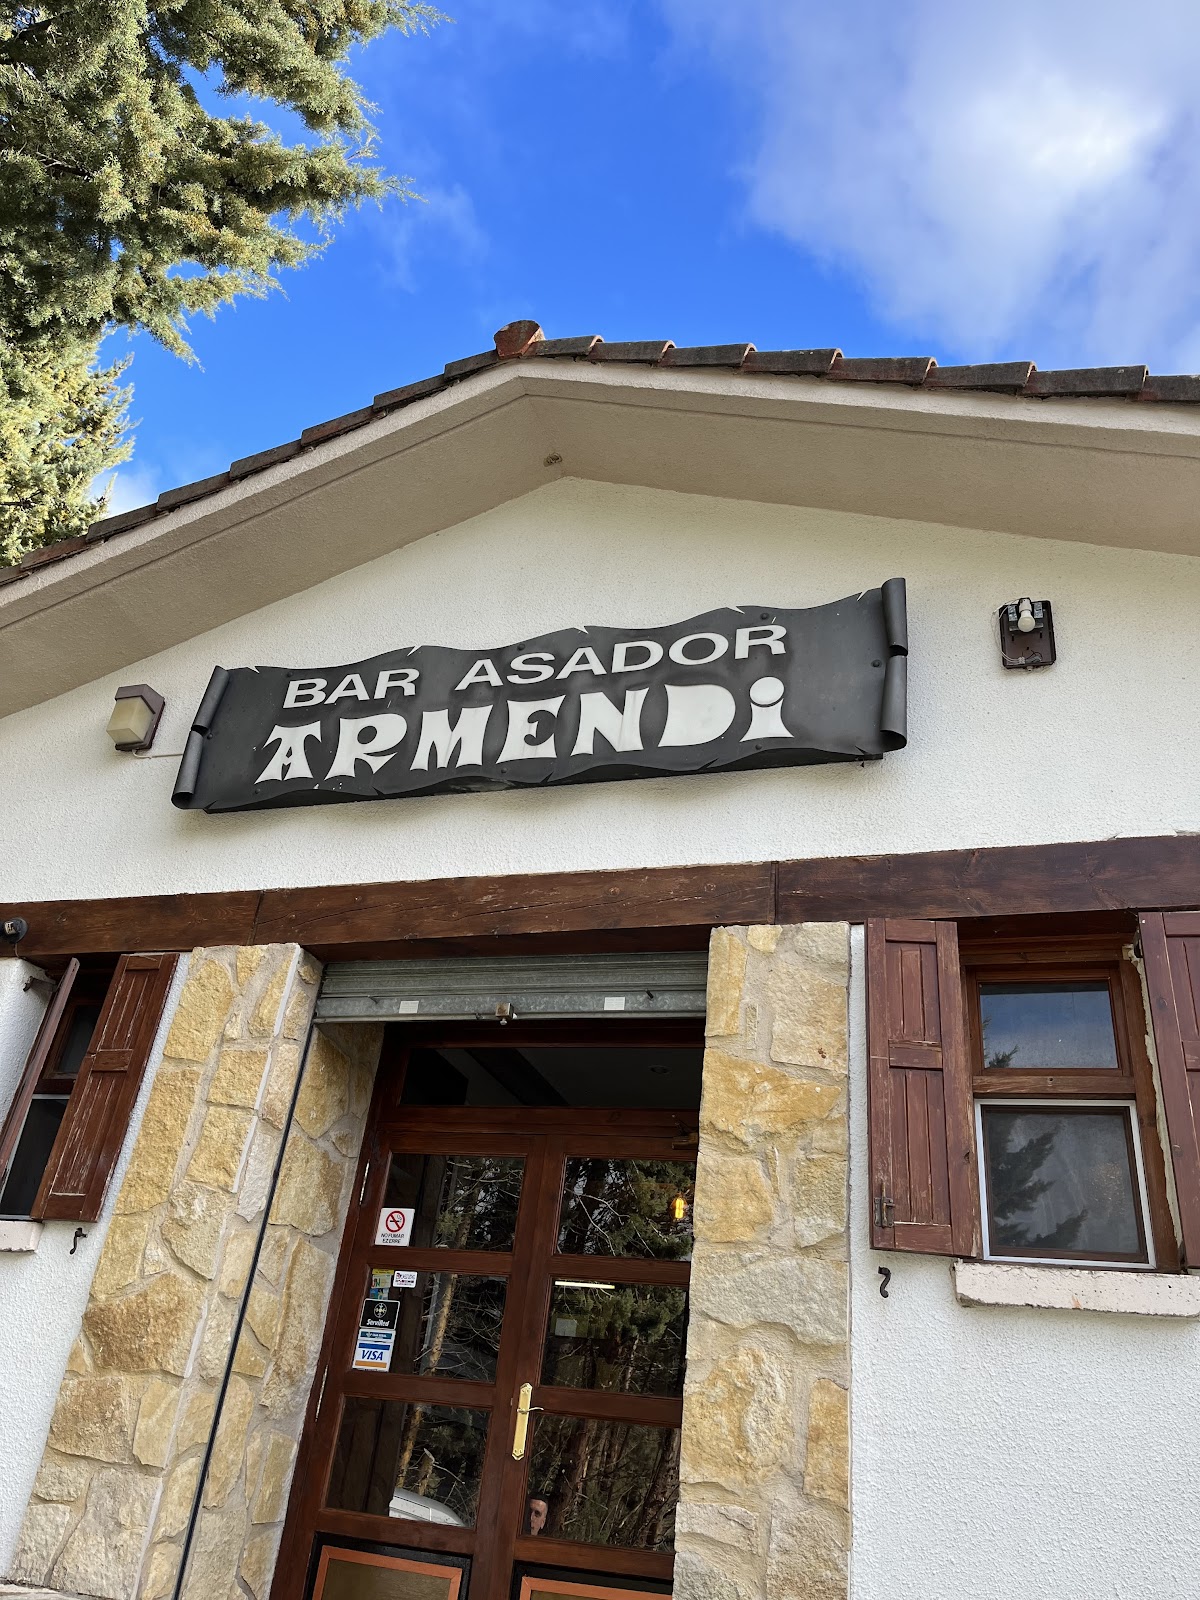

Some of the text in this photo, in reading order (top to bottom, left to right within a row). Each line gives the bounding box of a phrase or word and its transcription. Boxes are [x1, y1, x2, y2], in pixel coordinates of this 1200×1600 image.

[283, 624, 787, 708] BAR ASADOR
[366, 1318, 390, 1327] ServiRed
[361, 1349, 384, 1361] VISA
